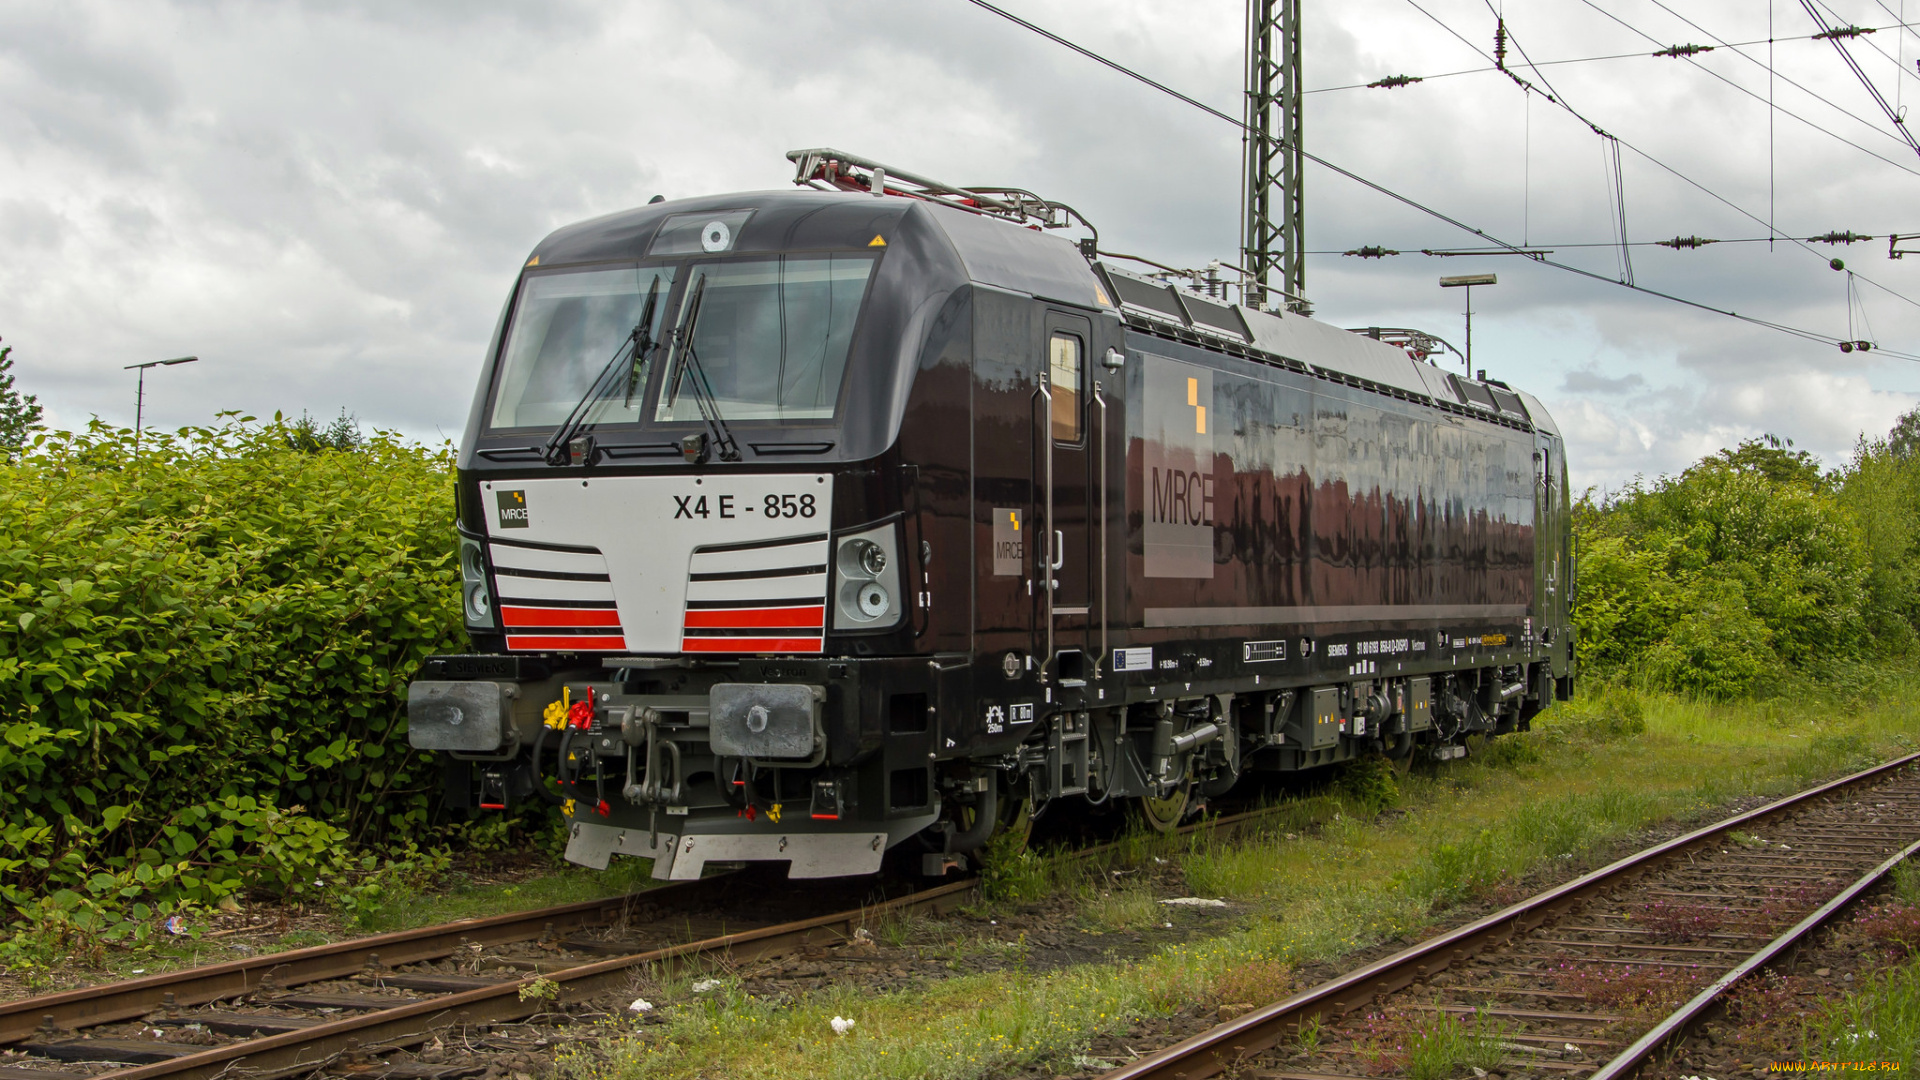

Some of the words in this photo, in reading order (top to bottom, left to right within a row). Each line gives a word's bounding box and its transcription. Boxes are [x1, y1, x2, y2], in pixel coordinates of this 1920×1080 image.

[1152, 466, 1213, 526] MRCE
[673, 495, 710, 519] X4
[718, 495, 735, 519] E
[763, 493, 816, 519] 858
[501, 508, 529, 520] MRCE
[996, 541, 1023, 559] MRCE
[1327, 643, 1348, 657] SIEMENS
[456, 662, 506, 673] SIEMENS
[987, 723, 1003, 734] 250m
